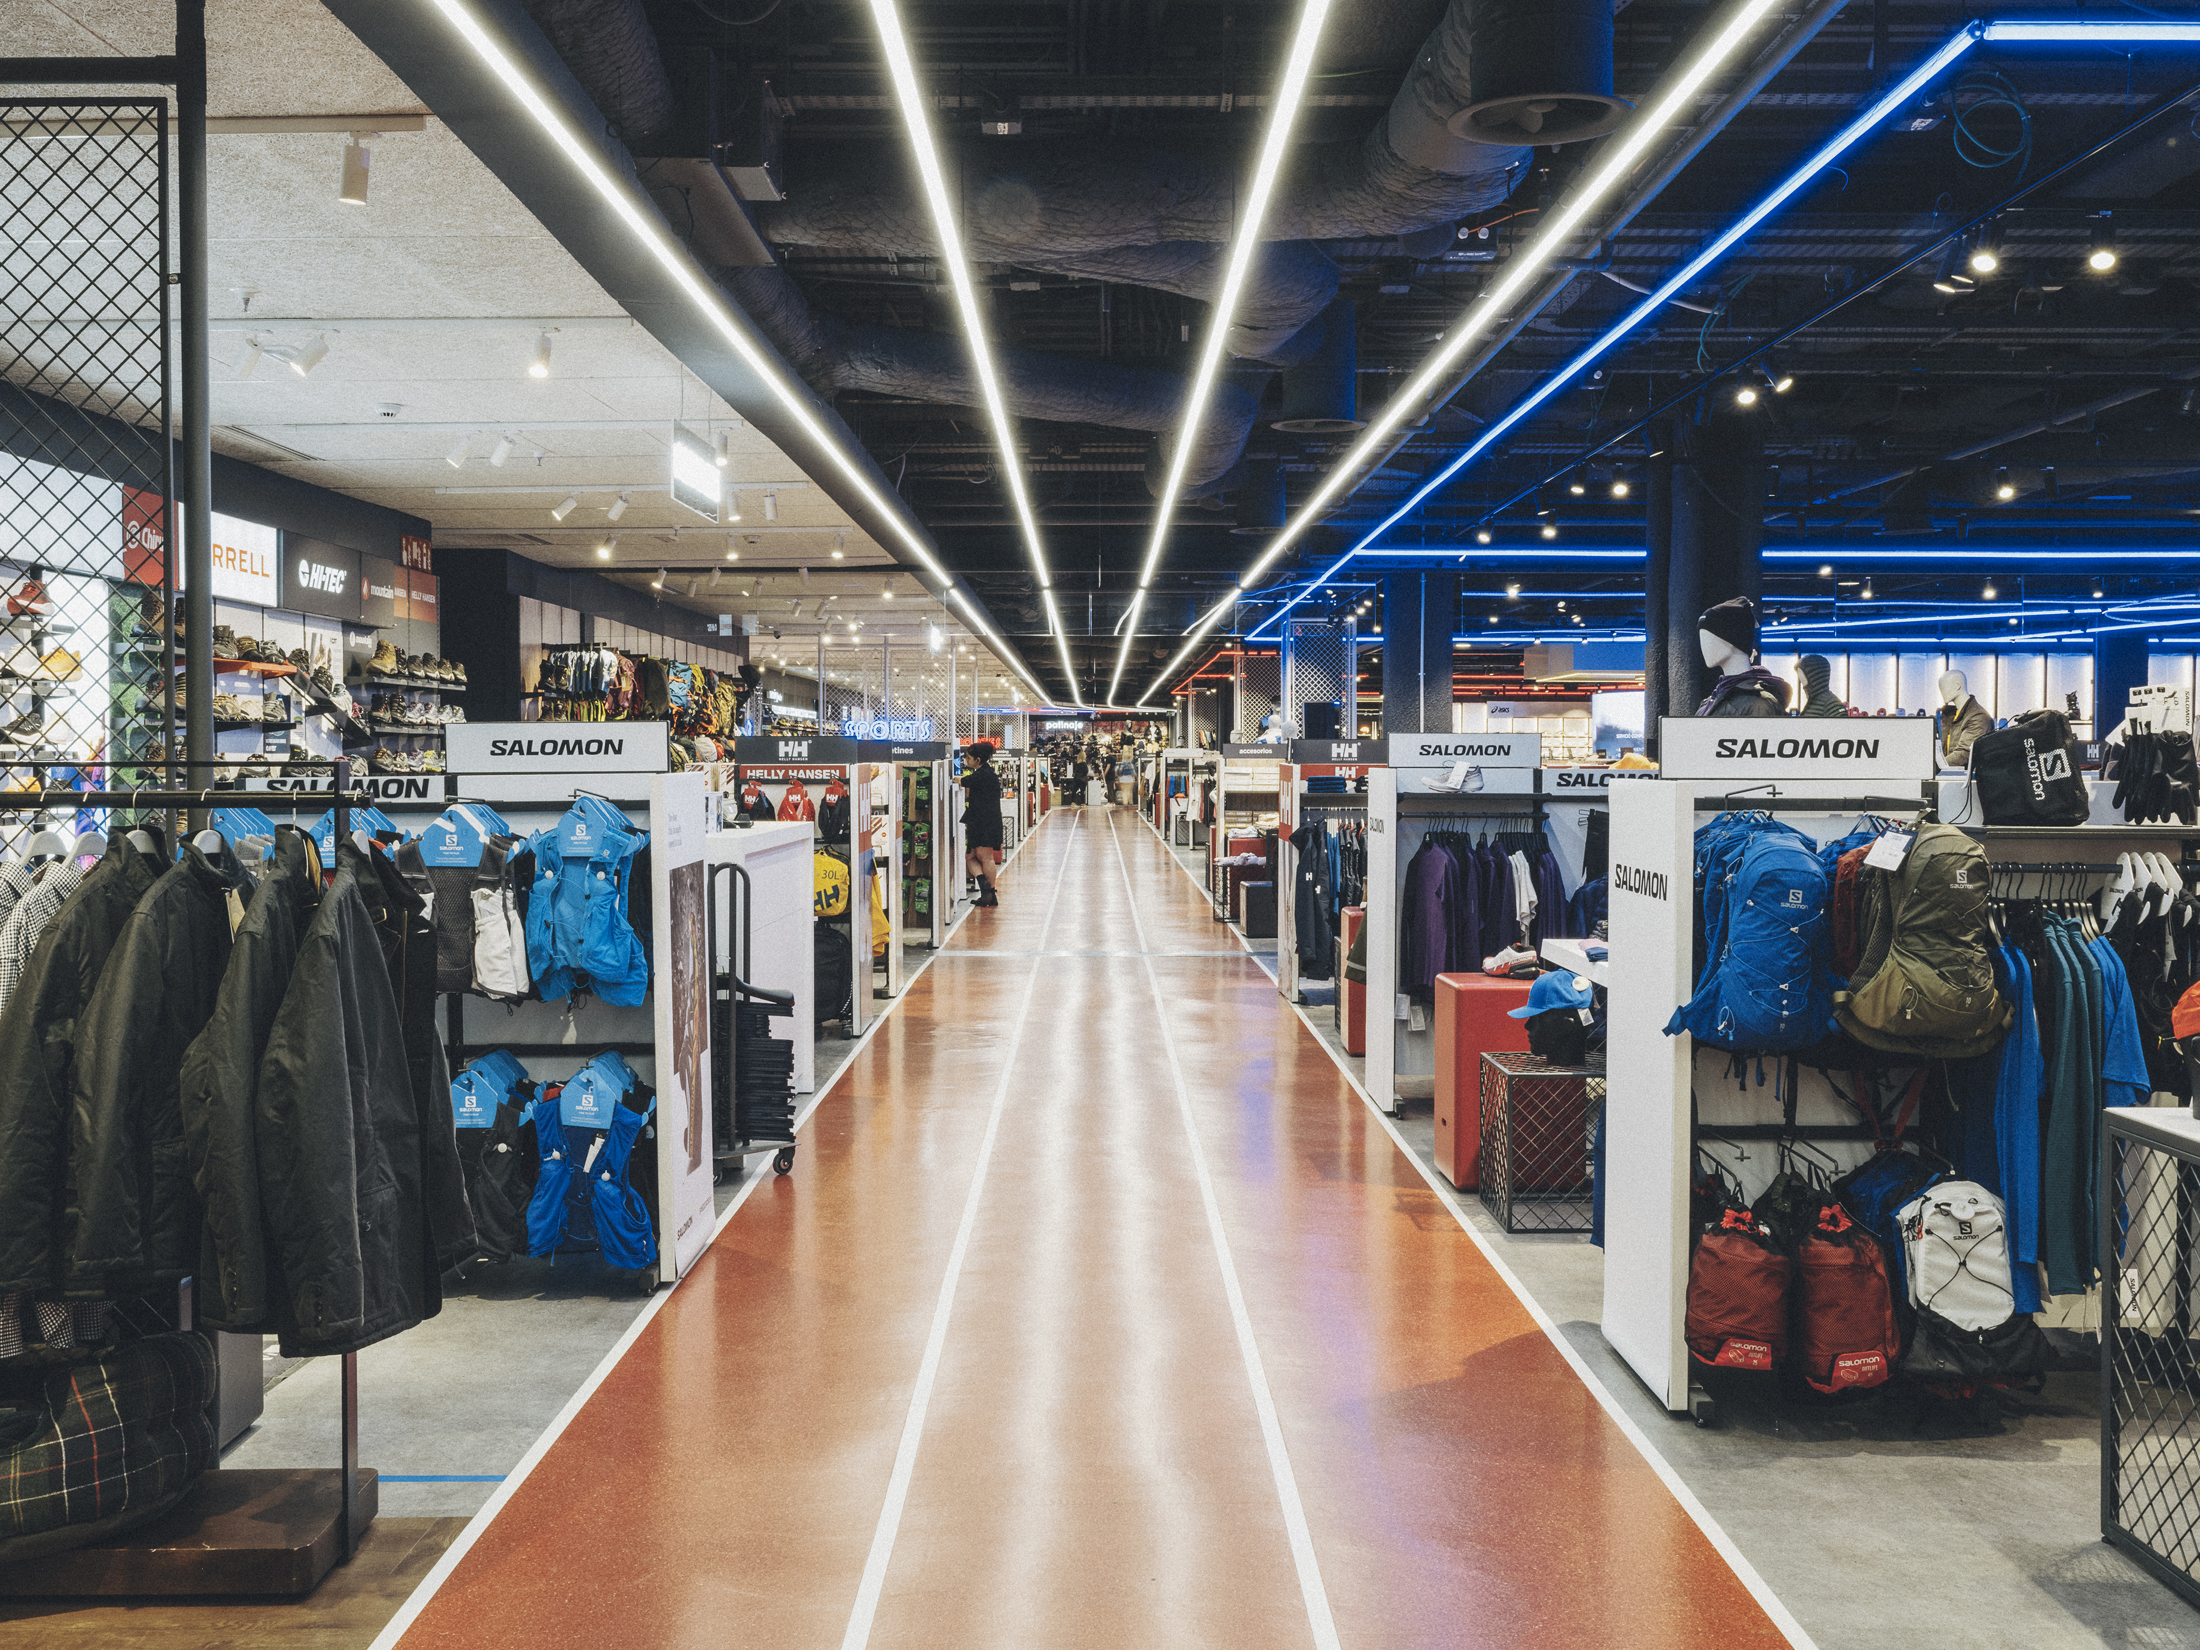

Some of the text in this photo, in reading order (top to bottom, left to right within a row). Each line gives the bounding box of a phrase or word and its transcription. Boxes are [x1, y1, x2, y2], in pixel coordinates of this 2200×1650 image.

[142, 526, 164, 552] Chiru
[212, 543, 270, 578] RRELL
[394, 587, 407, 598] ANSEN
[1046, 721, 1084, 731] patinaje
[490, 739, 624, 756] SALOMON
[779, 741, 808, 757] HH
[1239, 747, 1273, 755] accesorios
[1332, 743, 1358, 757] HH
[1419, 744, 1511, 757] SALOMON
[1715, 739, 1880, 759] SALOMON
[747, 769, 840, 779] HELLY HANSEN
[2023, 737, 2046, 801] salomon
[821, 869, 840, 880] 30L
[1615, 864, 1668, 901] SALOMON
[1780, 902, 1808, 910] salomon
[1730, 1342, 1767, 1352] salomon
[1838, 1356, 1880, 1367] salomon
